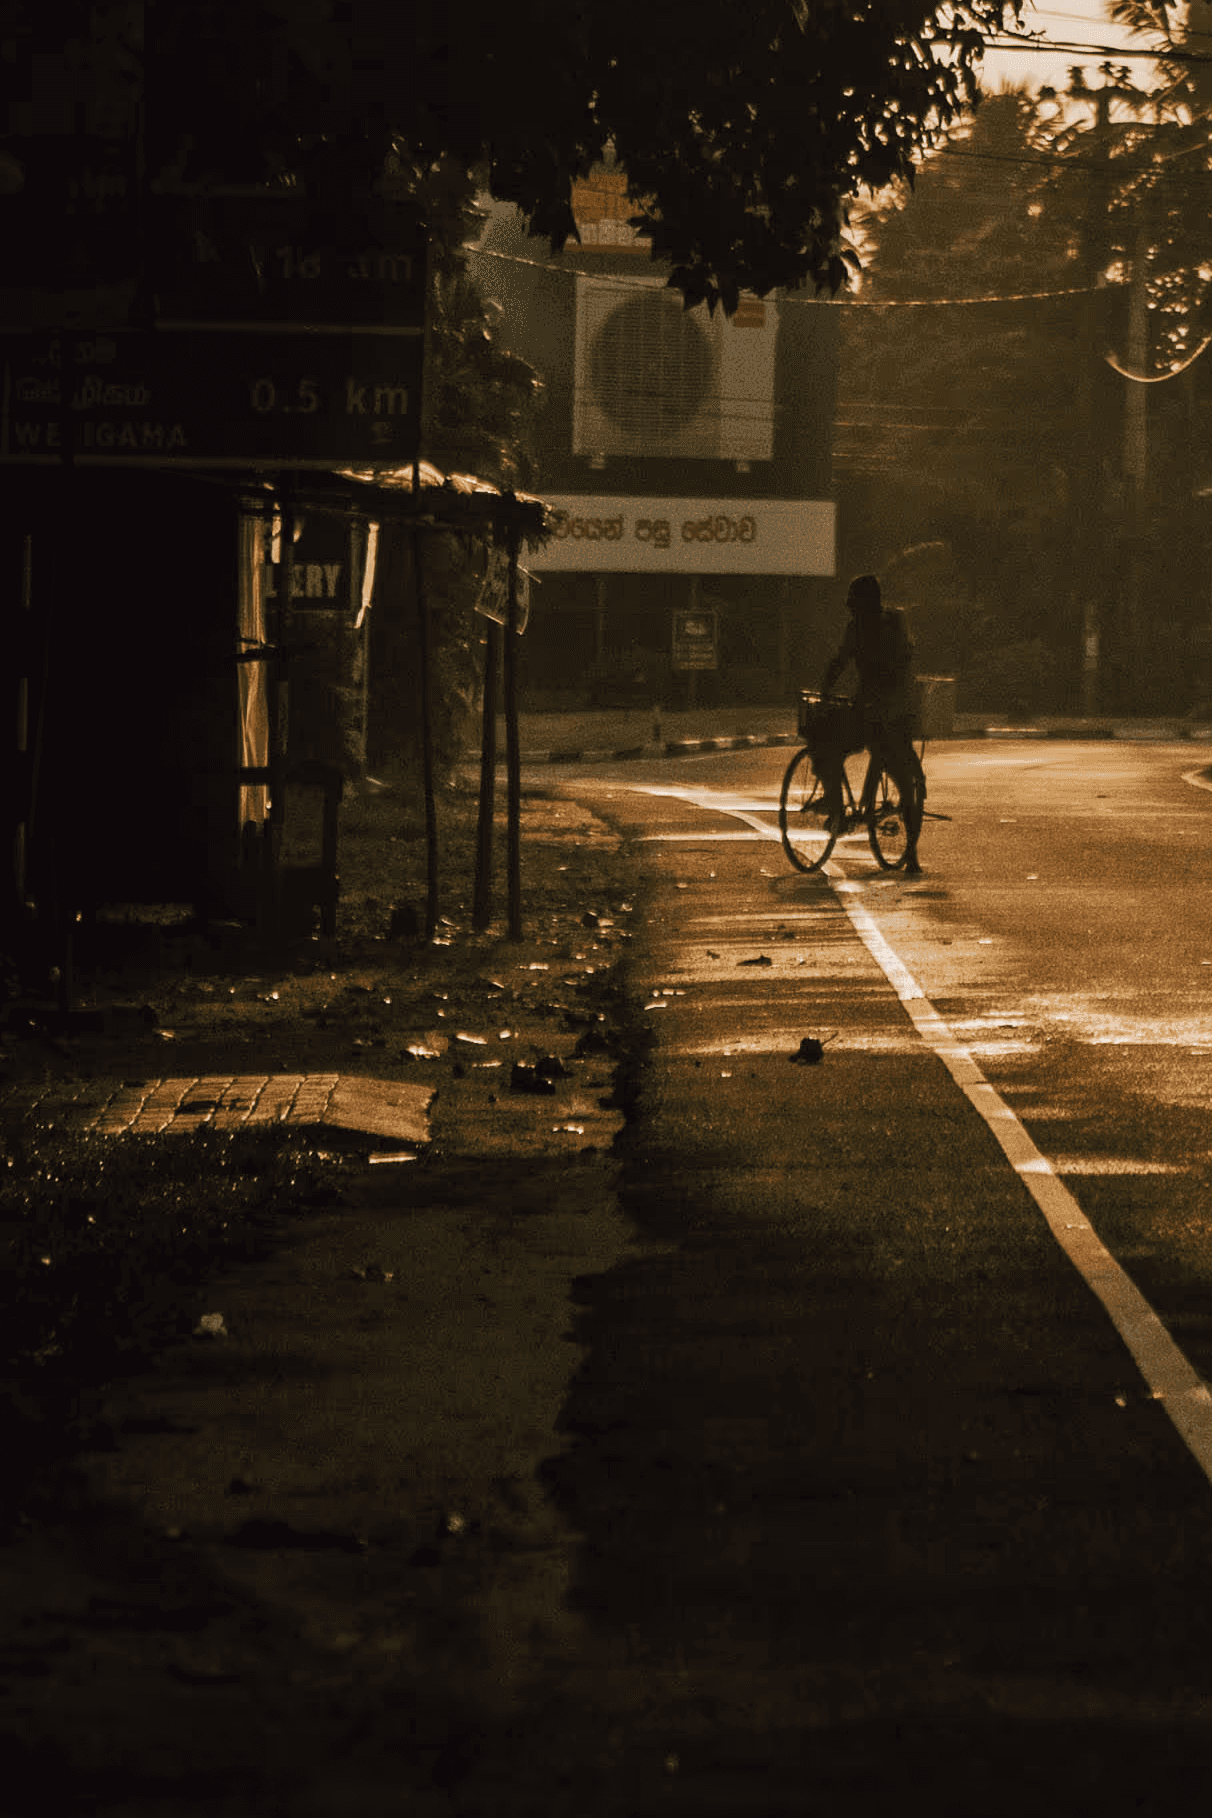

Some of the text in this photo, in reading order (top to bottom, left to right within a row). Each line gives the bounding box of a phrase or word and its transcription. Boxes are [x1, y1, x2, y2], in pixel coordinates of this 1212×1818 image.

[249, 375, 409, 415] 0.5 km
[14, 421, 188, 447] WEIGAMA
